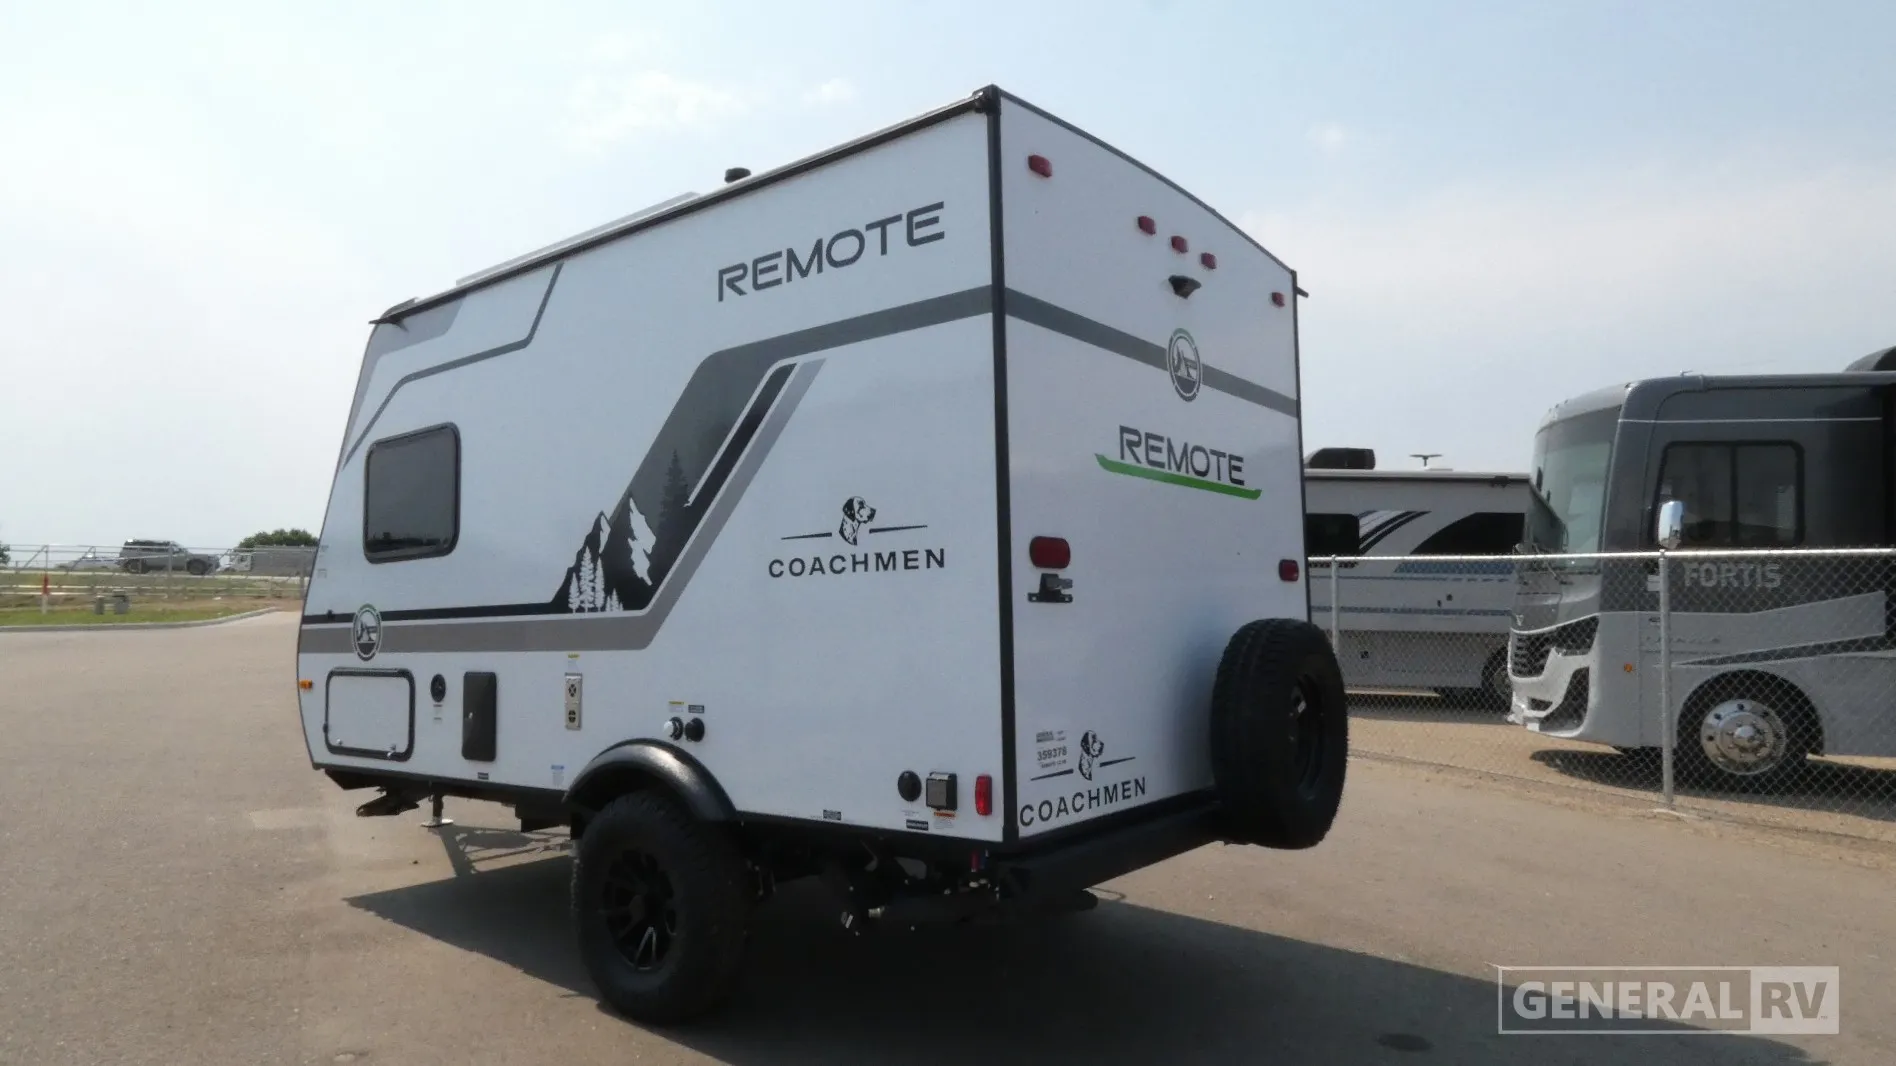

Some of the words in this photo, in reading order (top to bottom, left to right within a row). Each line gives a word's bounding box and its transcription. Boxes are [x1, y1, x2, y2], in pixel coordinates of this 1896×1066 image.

[717, 200, 945, 302] REMOTE
[1118, 424, 1246, 487] REMOTE
[768, 548, 946, 578] COACHMEN
[1682, 561, 1782, 588] FORTIS
[1019, 776, 1147, 827] COACHMEN
